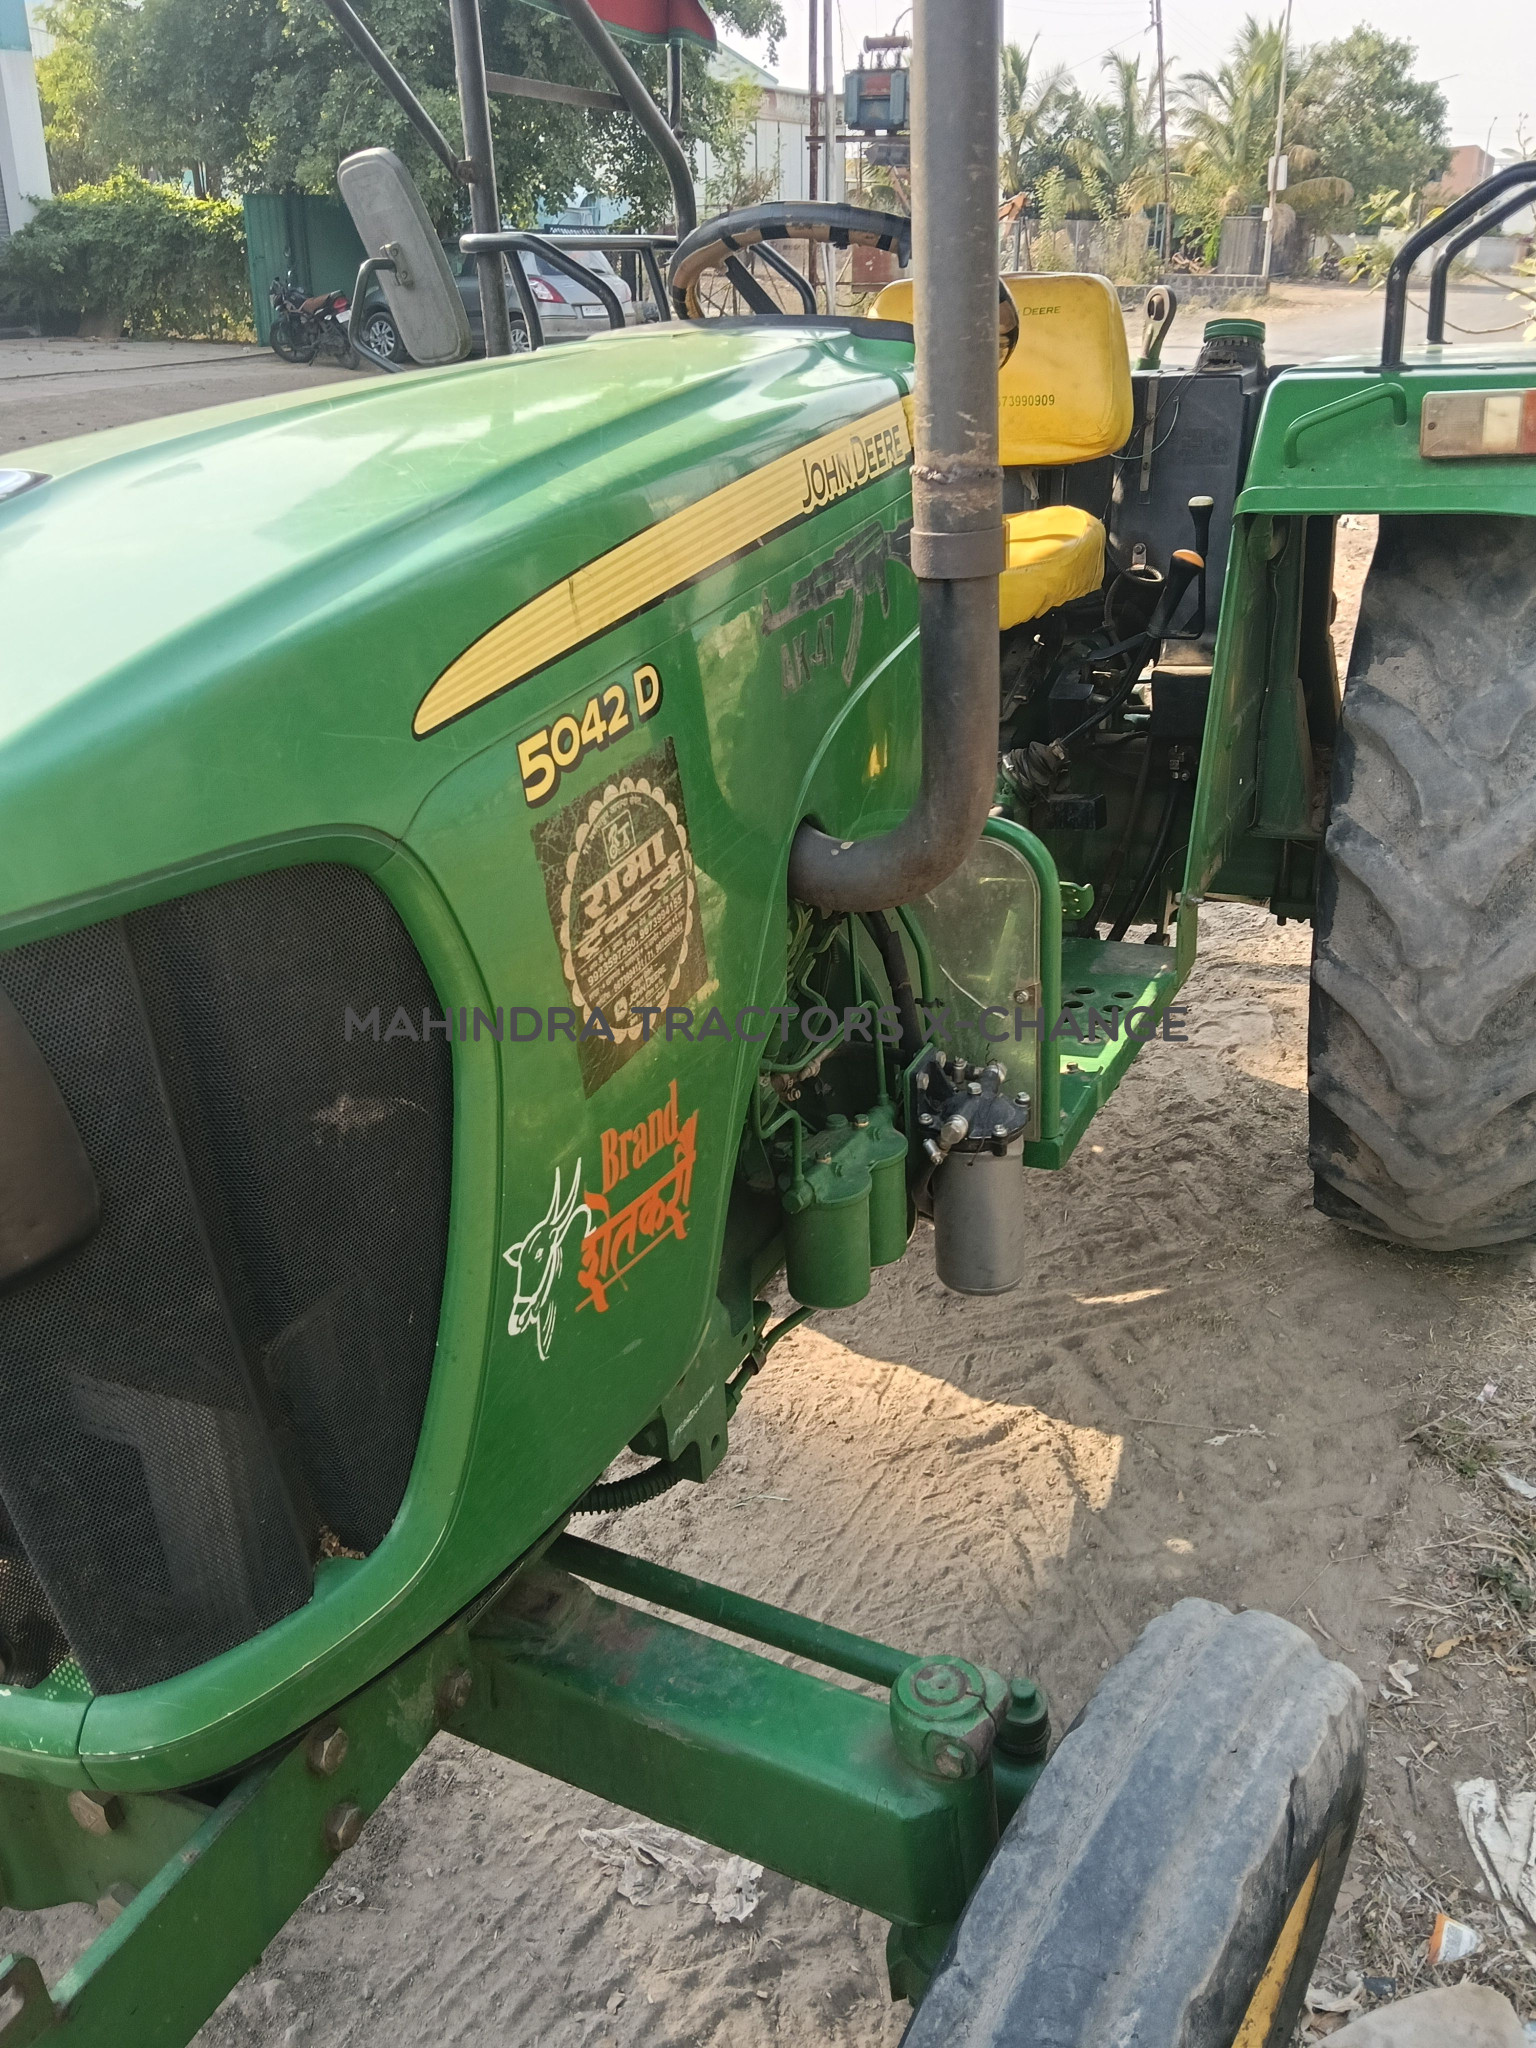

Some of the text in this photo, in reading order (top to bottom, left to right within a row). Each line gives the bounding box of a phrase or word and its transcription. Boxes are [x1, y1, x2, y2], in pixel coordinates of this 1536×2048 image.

[1022, 306, 1061, 316] DEERE
[802, 425, 904, 509] JOHN DEERE
[516, 662, 664, 809] 5042 D
[580, 827, 666, 919] रामा
[600, 1078, 679, 1195] Brand
